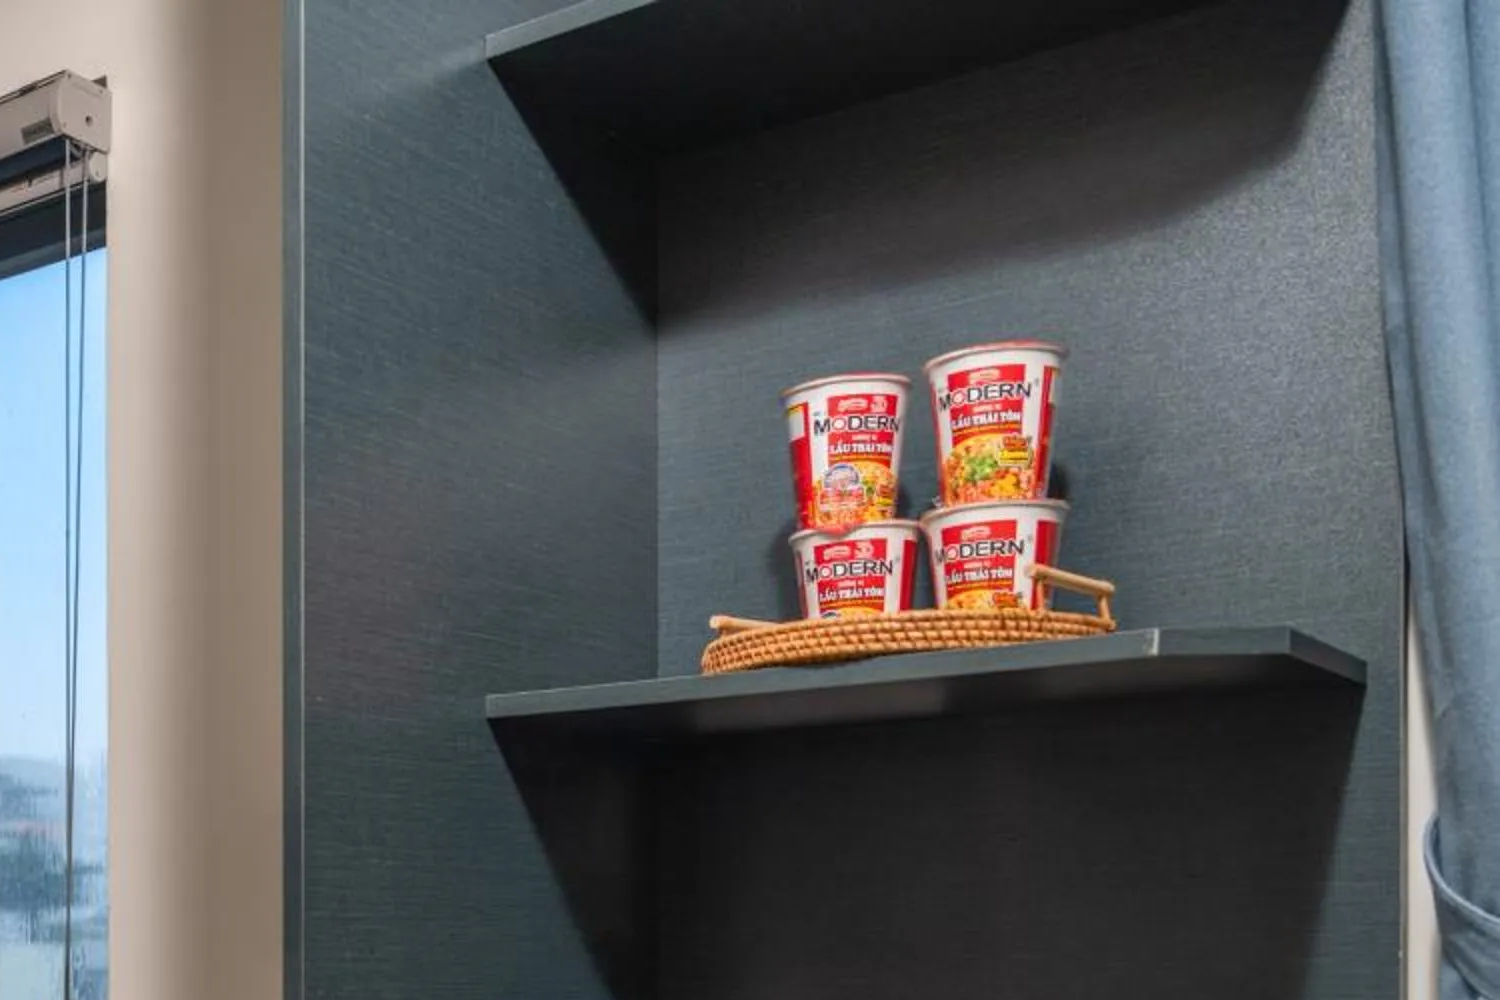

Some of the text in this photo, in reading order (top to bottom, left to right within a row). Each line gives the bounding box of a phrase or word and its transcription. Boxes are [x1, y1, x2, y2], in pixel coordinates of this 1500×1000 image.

[939, 383, 1032, 411] MODERN
[813, 415, 900, 435] MODERN
[937, 539, 1025, 563] MODERN
[805, 559, 893, 583] MODERN
